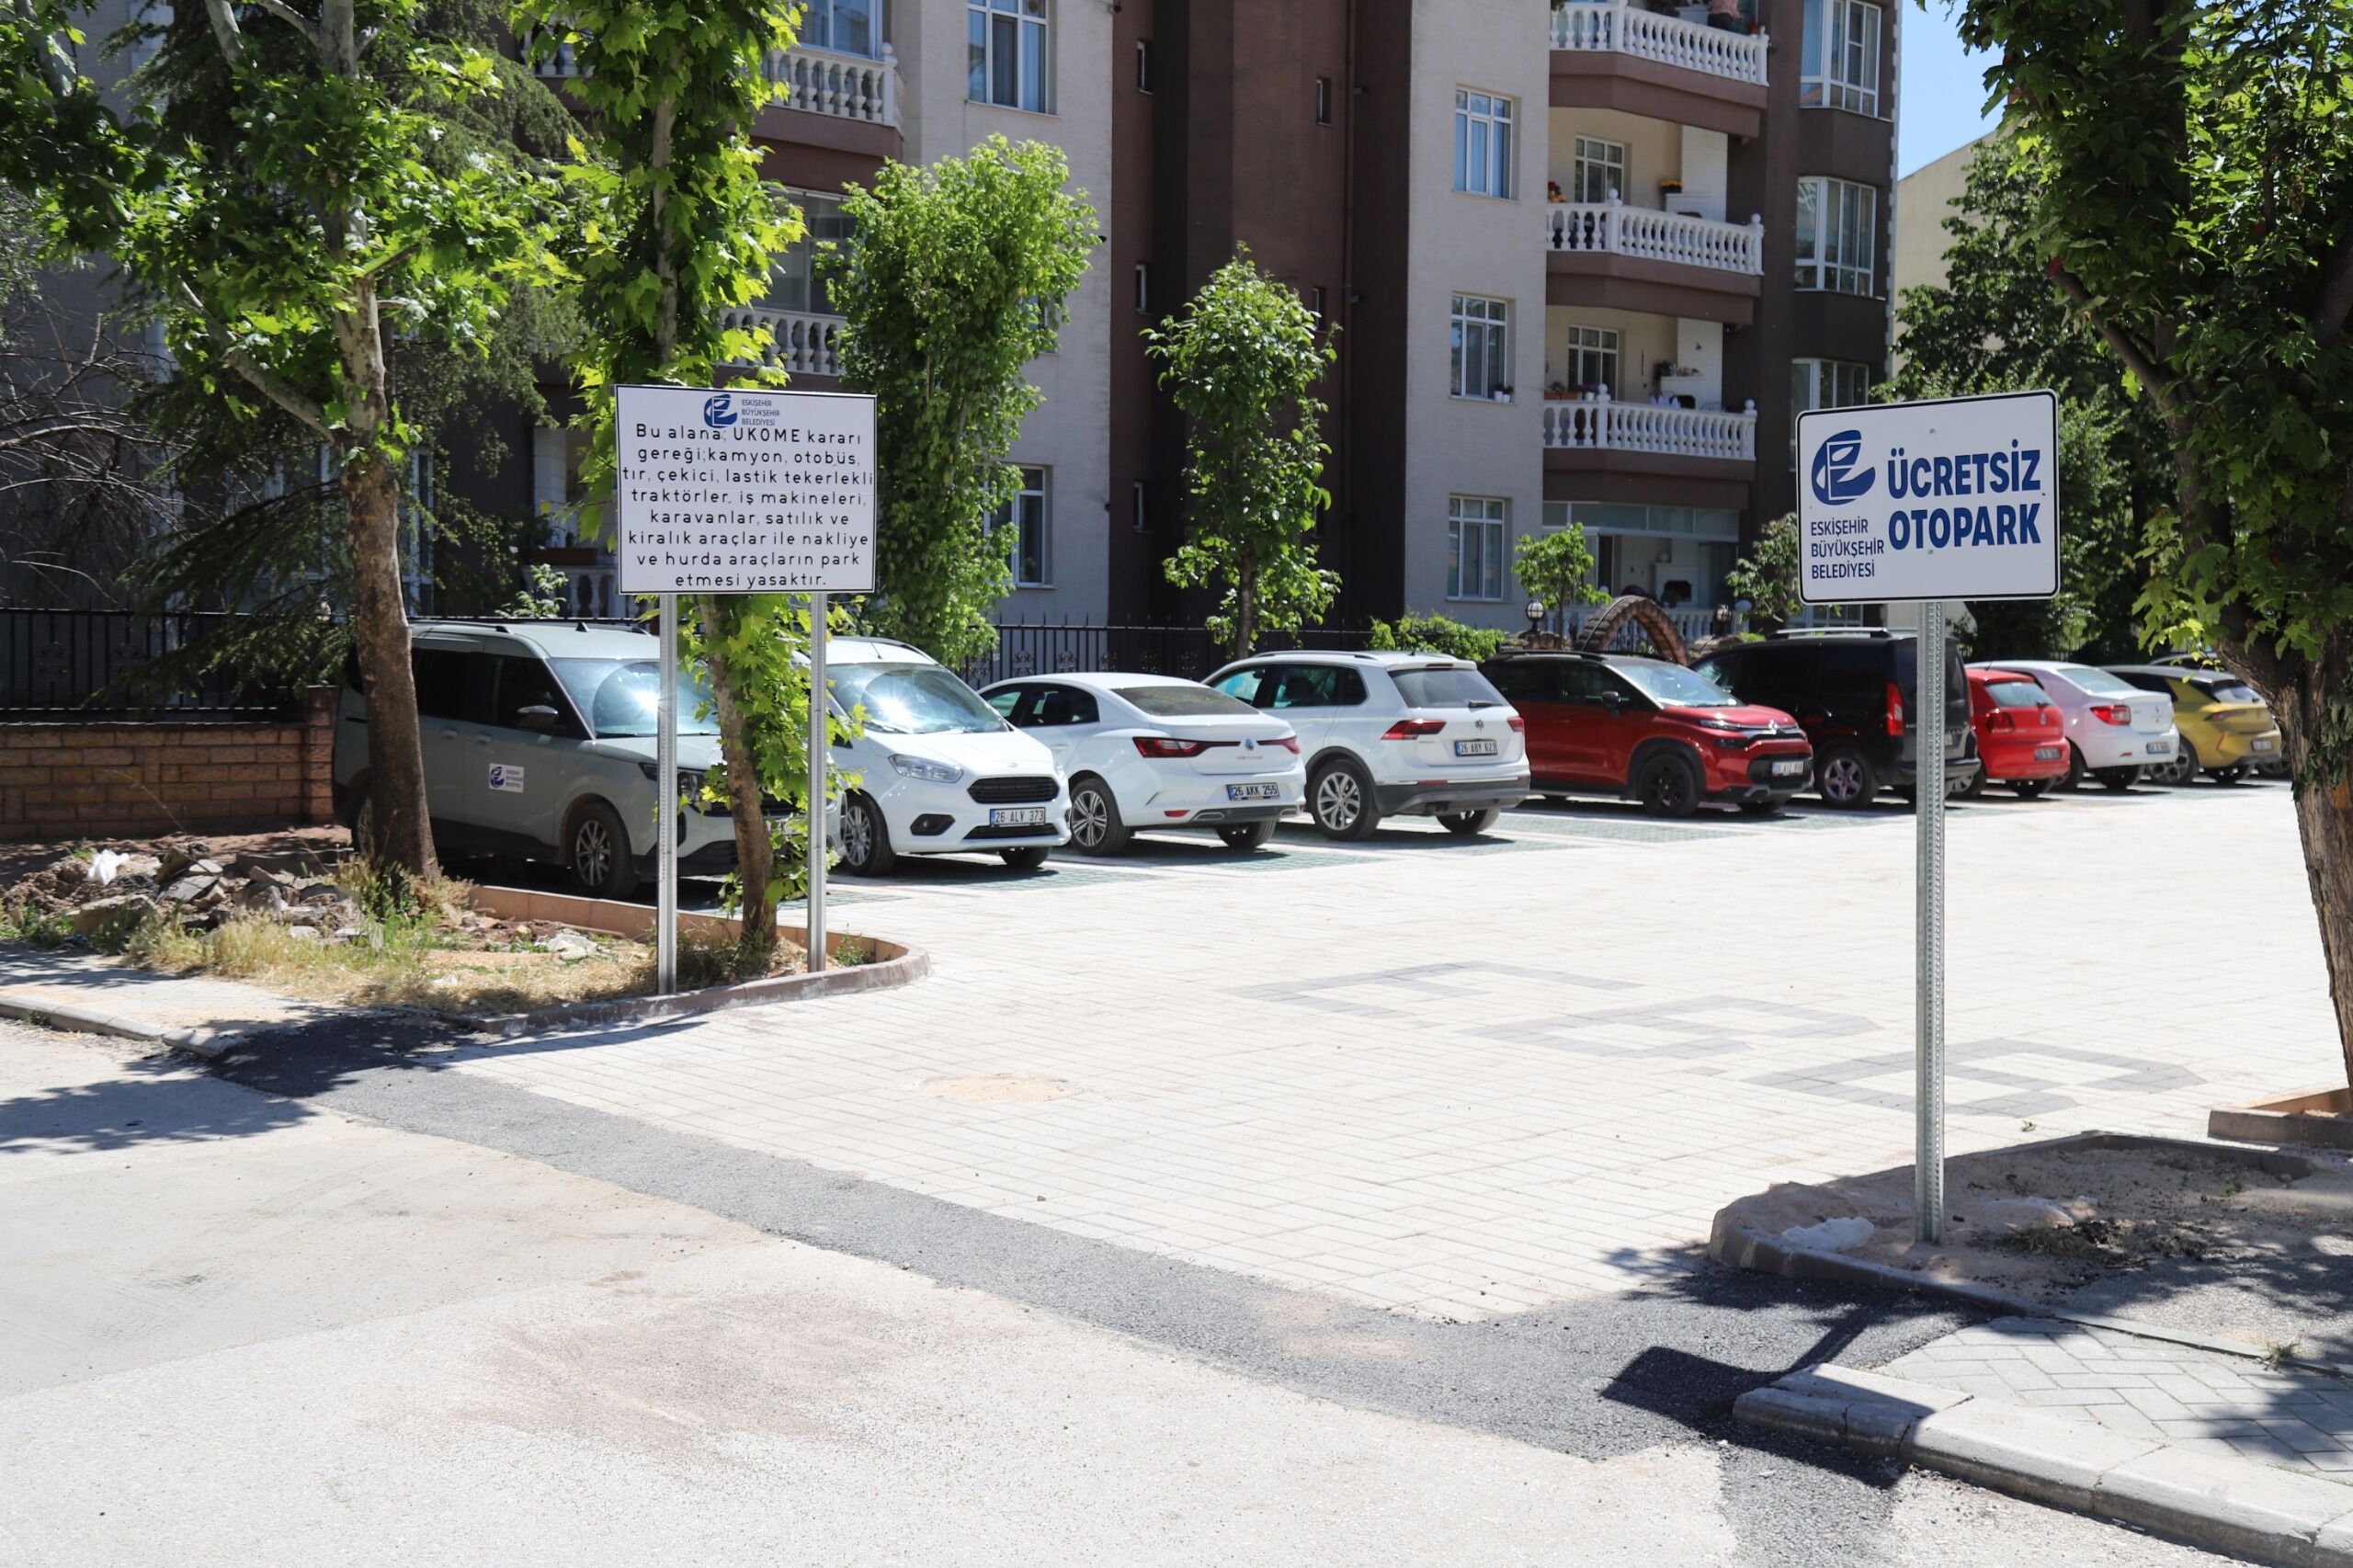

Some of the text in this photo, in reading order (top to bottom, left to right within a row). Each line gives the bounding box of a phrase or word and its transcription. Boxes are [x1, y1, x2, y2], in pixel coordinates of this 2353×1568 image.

[636, 423, 660, 438] Bu
[733, 427, 801, 443] UKOME
[808, 429, 860, 444] kararı
[657, 467, 720, 483] çekici,
[726, 468, 778, 483] lastik
[784, 470, 873, 485] tekerlekli
[1887, 438, 2041, 499] ÜCRETSİZ
[739, 491, 754, 506] iş
[766, 511, 824, 525] satılık
[830, 515, 849, 525] ve
[1811, 516, 1869, 537] ESKİŞEHİR
[1888, 503, 2041, 551] OTOPARK
[629, 529, 869, 549] kiralık araçlar ile nakliye
[1811, 537, 1884, 559] BÜYÜKŞEHİR
[637, 551, 860, 569] ve hurda araçların park
[1812, 560, 1875, 580] BELEDİYESİ
[676, 572, 826, 589] etmesi yasaktır.
[1233, 787, 1244, 796] 26
[1262, 785, 1278, 795] 255
[995, 810, 1044, 824] 26 ALV 373
